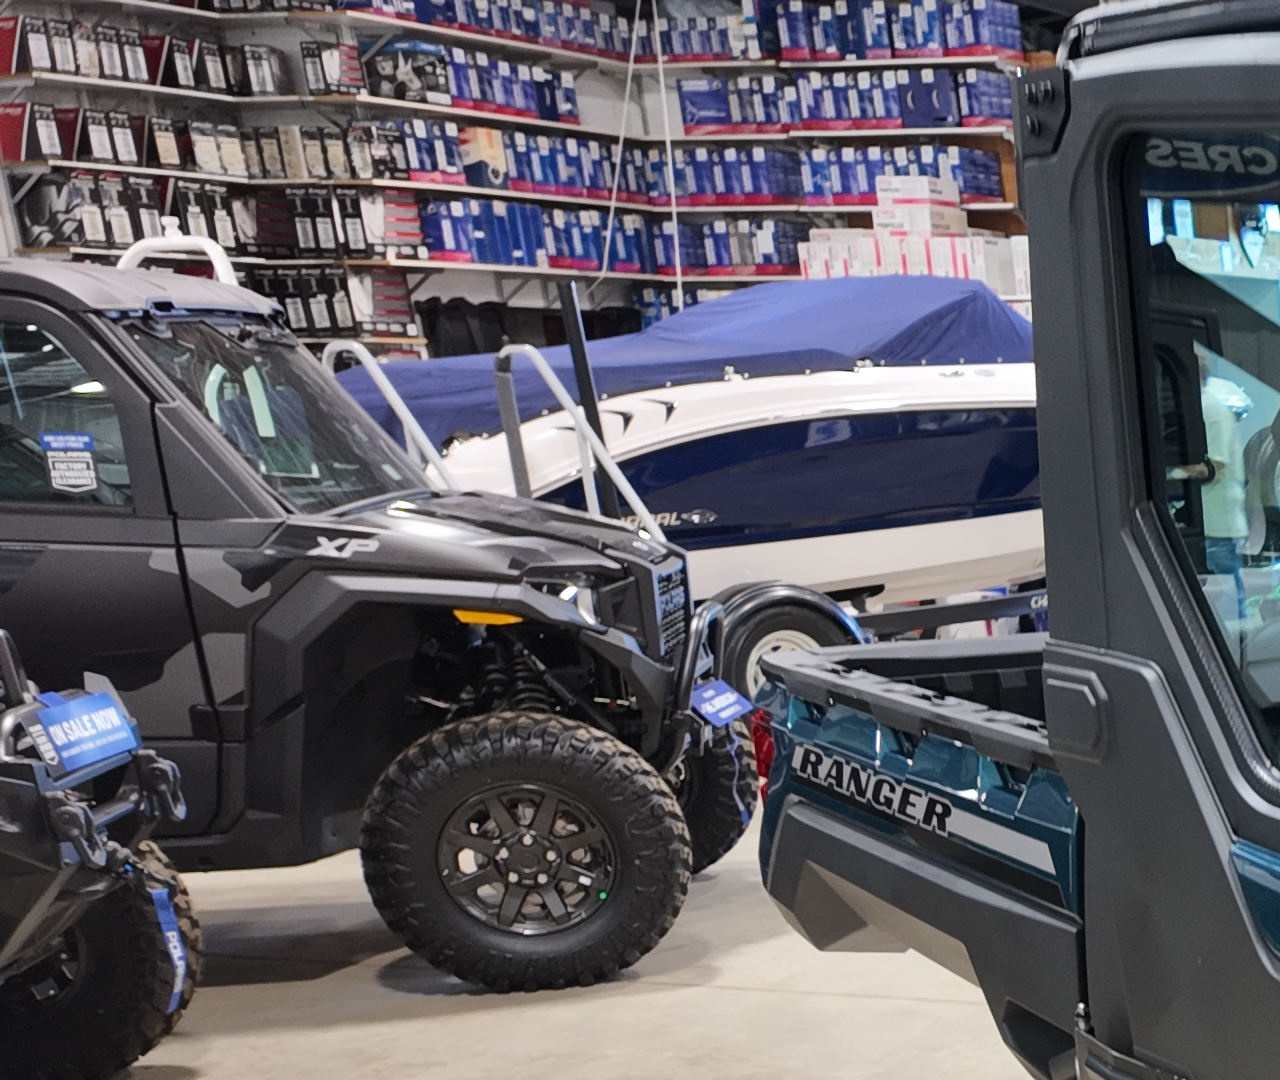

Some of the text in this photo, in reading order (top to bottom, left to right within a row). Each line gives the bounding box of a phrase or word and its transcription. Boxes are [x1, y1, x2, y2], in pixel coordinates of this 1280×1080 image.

[305, 536, 380, 558] XP
[48, 724, 69, 747] ON
[62, 714, 98, 742] SALE
[90, 706, 122, 733] NOW
[798, 745, 953, 835] RANGER
